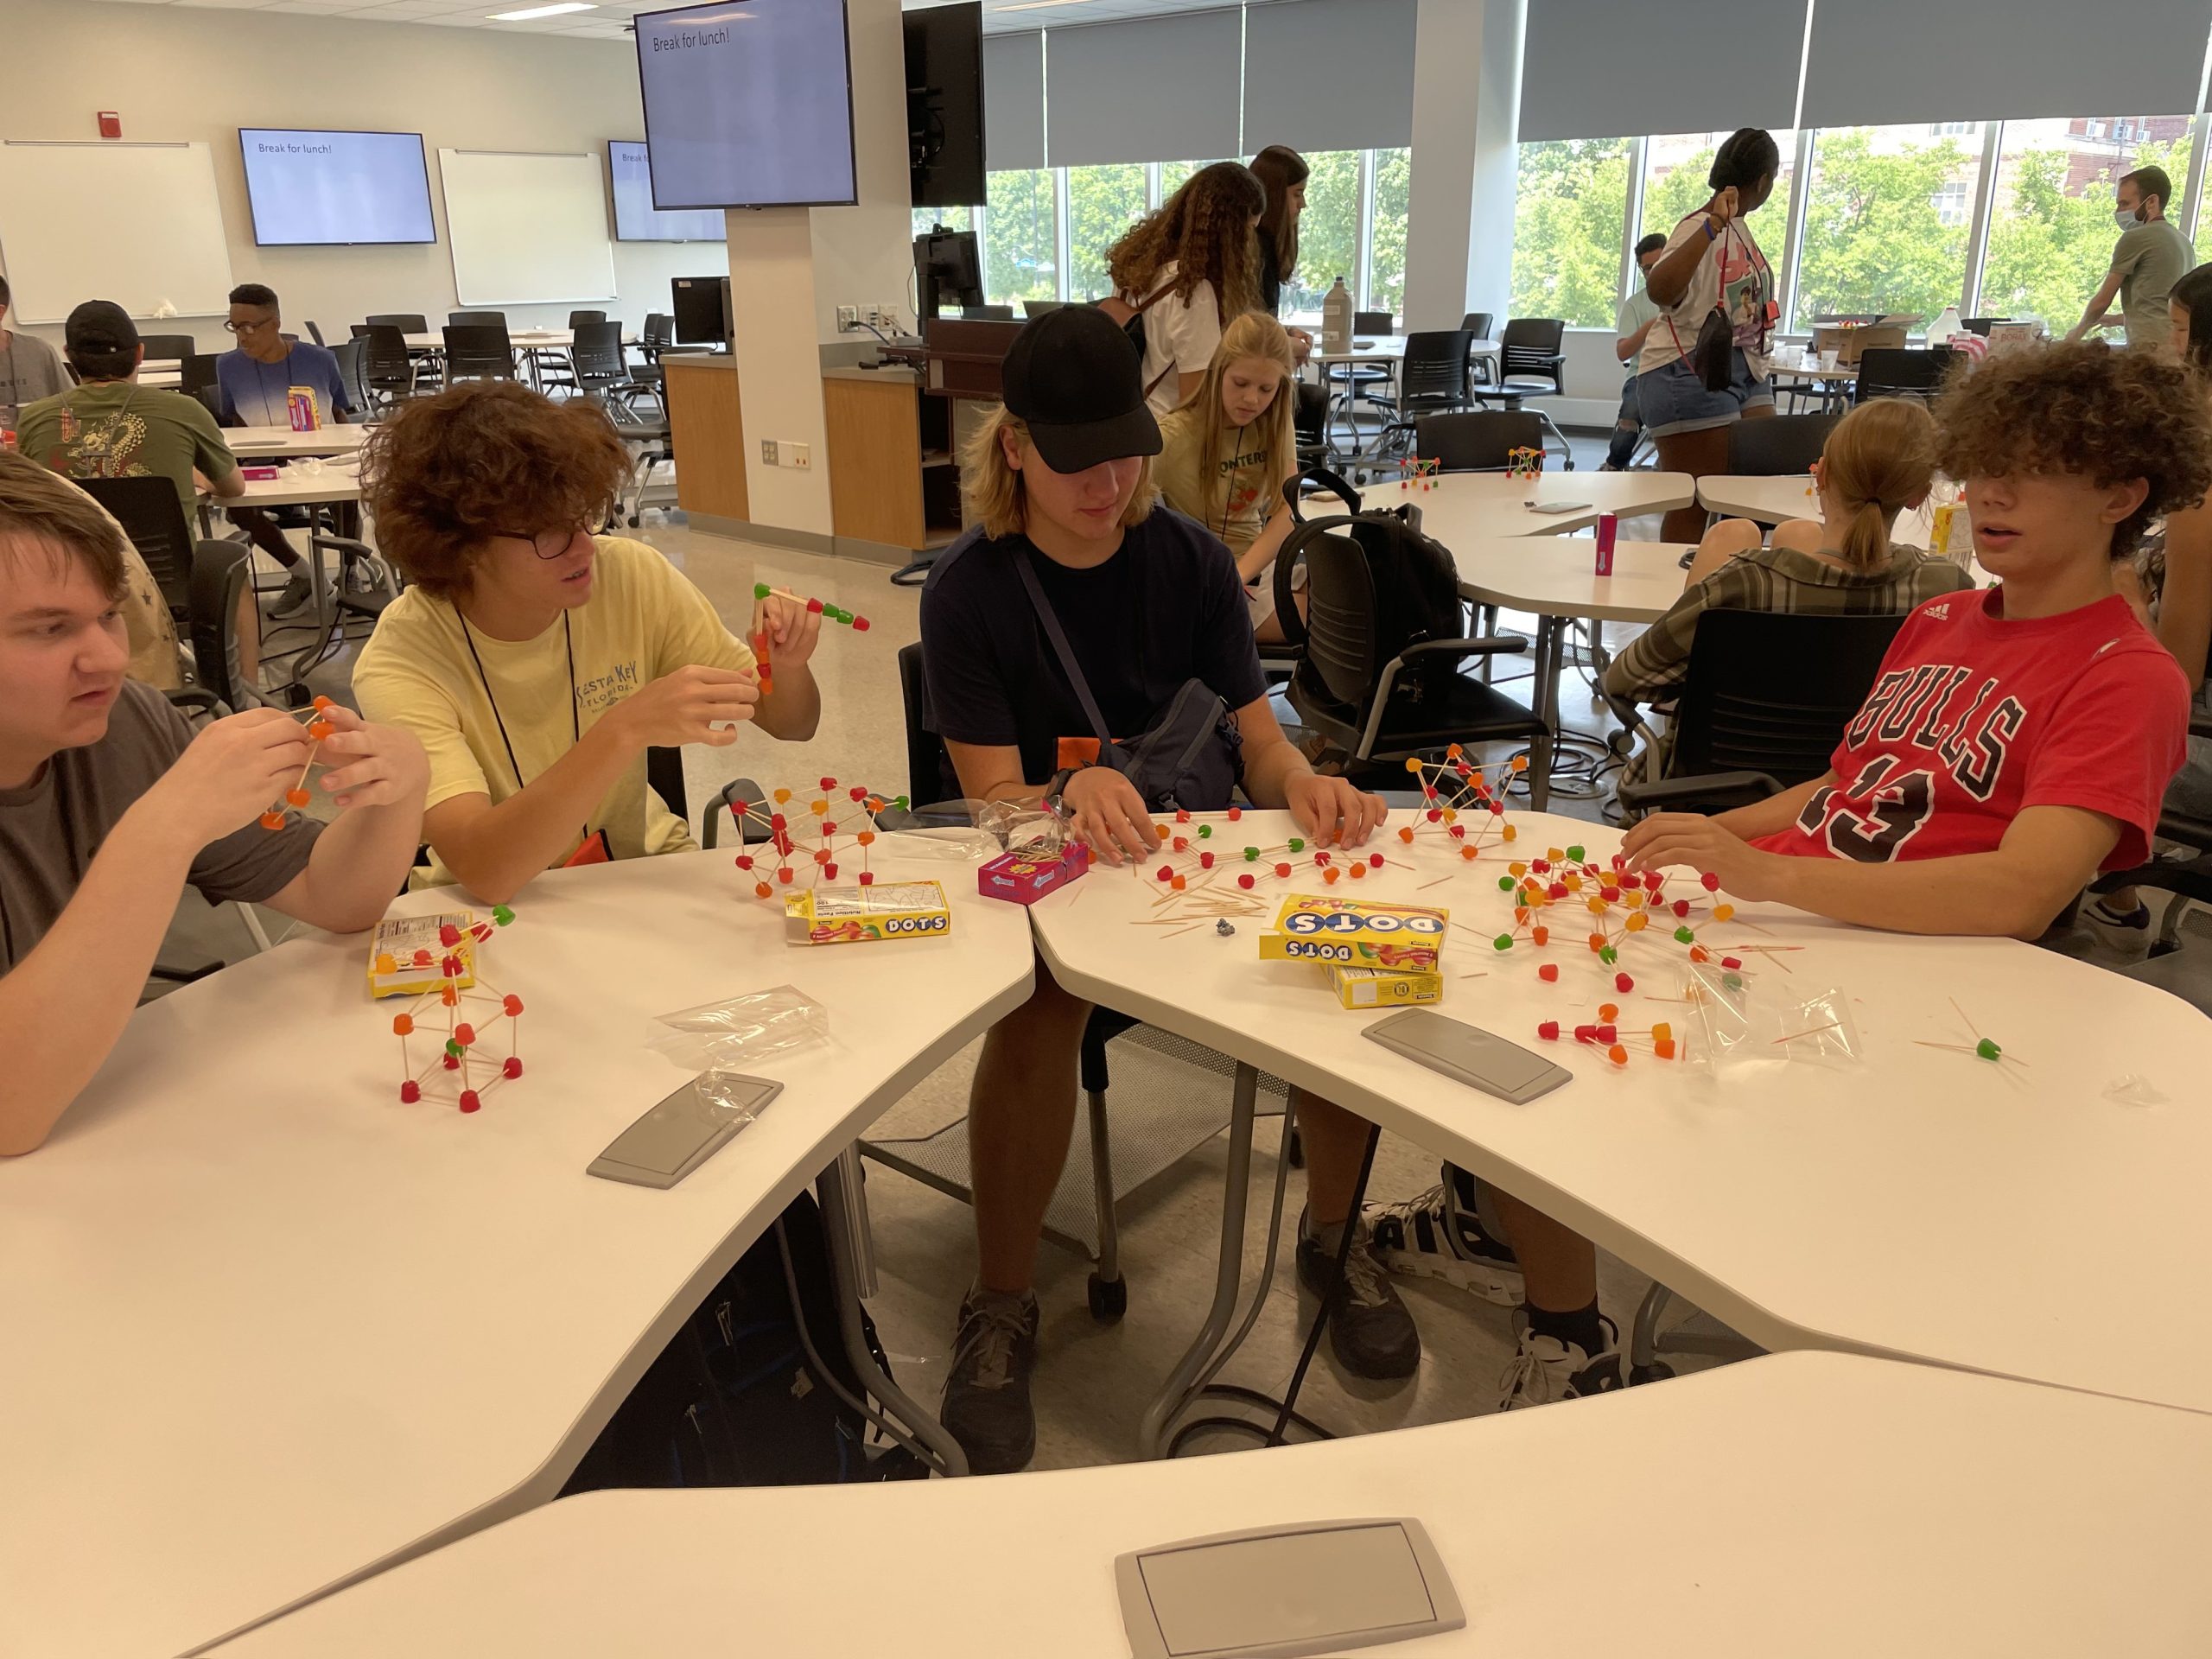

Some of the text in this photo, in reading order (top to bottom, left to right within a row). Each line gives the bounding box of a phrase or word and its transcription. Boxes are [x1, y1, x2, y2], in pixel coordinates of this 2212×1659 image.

[652, 27, 730, 52] Break for lunch!
[258, 143, 332, 154] Break for lunch!
[622, 153, 643, 162] Break
[614, 660, 638, 684] KEY
[1847, 664, 2027, 803] BULLS
[1796, 753, 1936, 862] 13
[887, 916, 946, 932] DOTS
[1292, 914, 1438, 933] DOTS
[1287, 941, 1351, 960] DOTS
